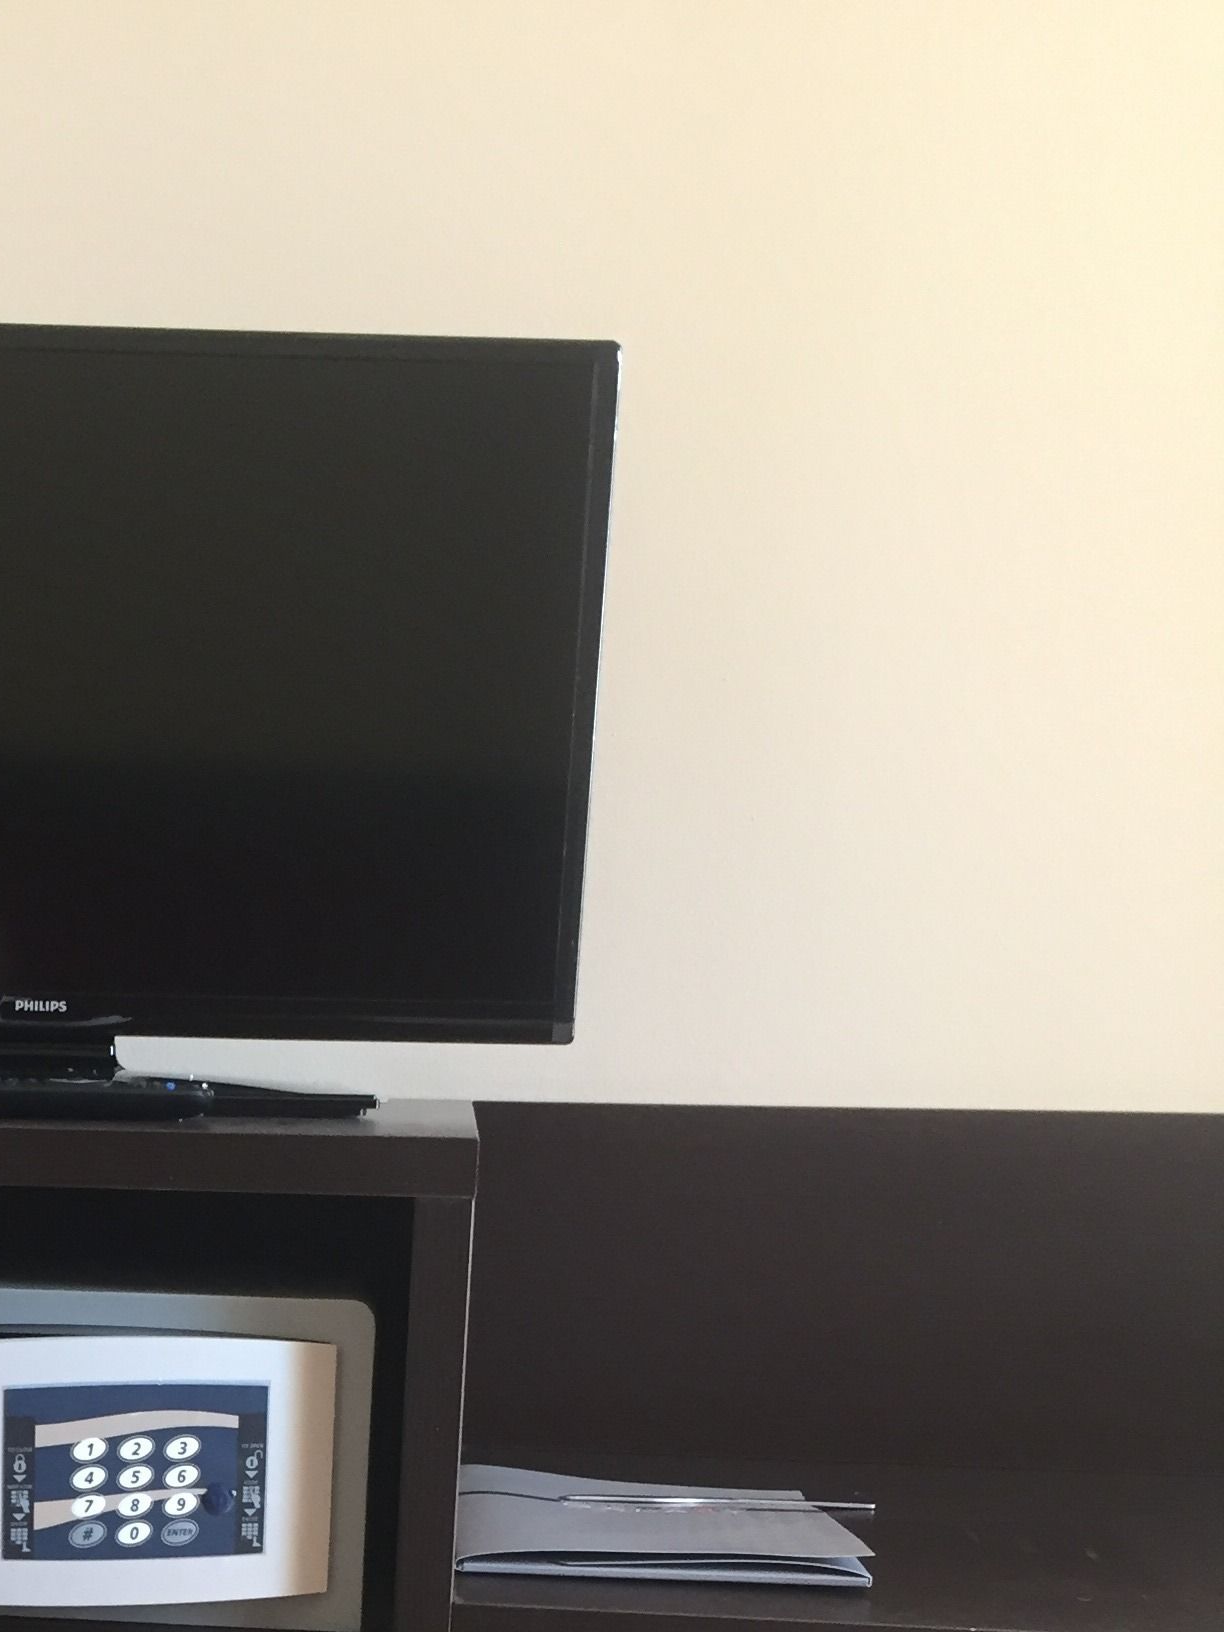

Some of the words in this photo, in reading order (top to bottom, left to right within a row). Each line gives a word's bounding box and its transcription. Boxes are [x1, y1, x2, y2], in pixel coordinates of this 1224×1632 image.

[15, 999, 67, 1012] PHILIPS
[87, 1442, 94, 1456] 1
[131, 1442, 141, 1456] 2
[177, 1441, 188, 1455] 3
[84, 1471, 94, 1485] 4
[130, 1470, 141, 1484] 5
[177, 1469, 187, 1483] 6
[84, 1499, 94, 1513] 7
[130, 1498, 140, 1512] 8
[176, 1497, 186, 1511] 9
[129, 1526, 139, 1540] 0
[167, 1528, 193, 1536] ENTER
